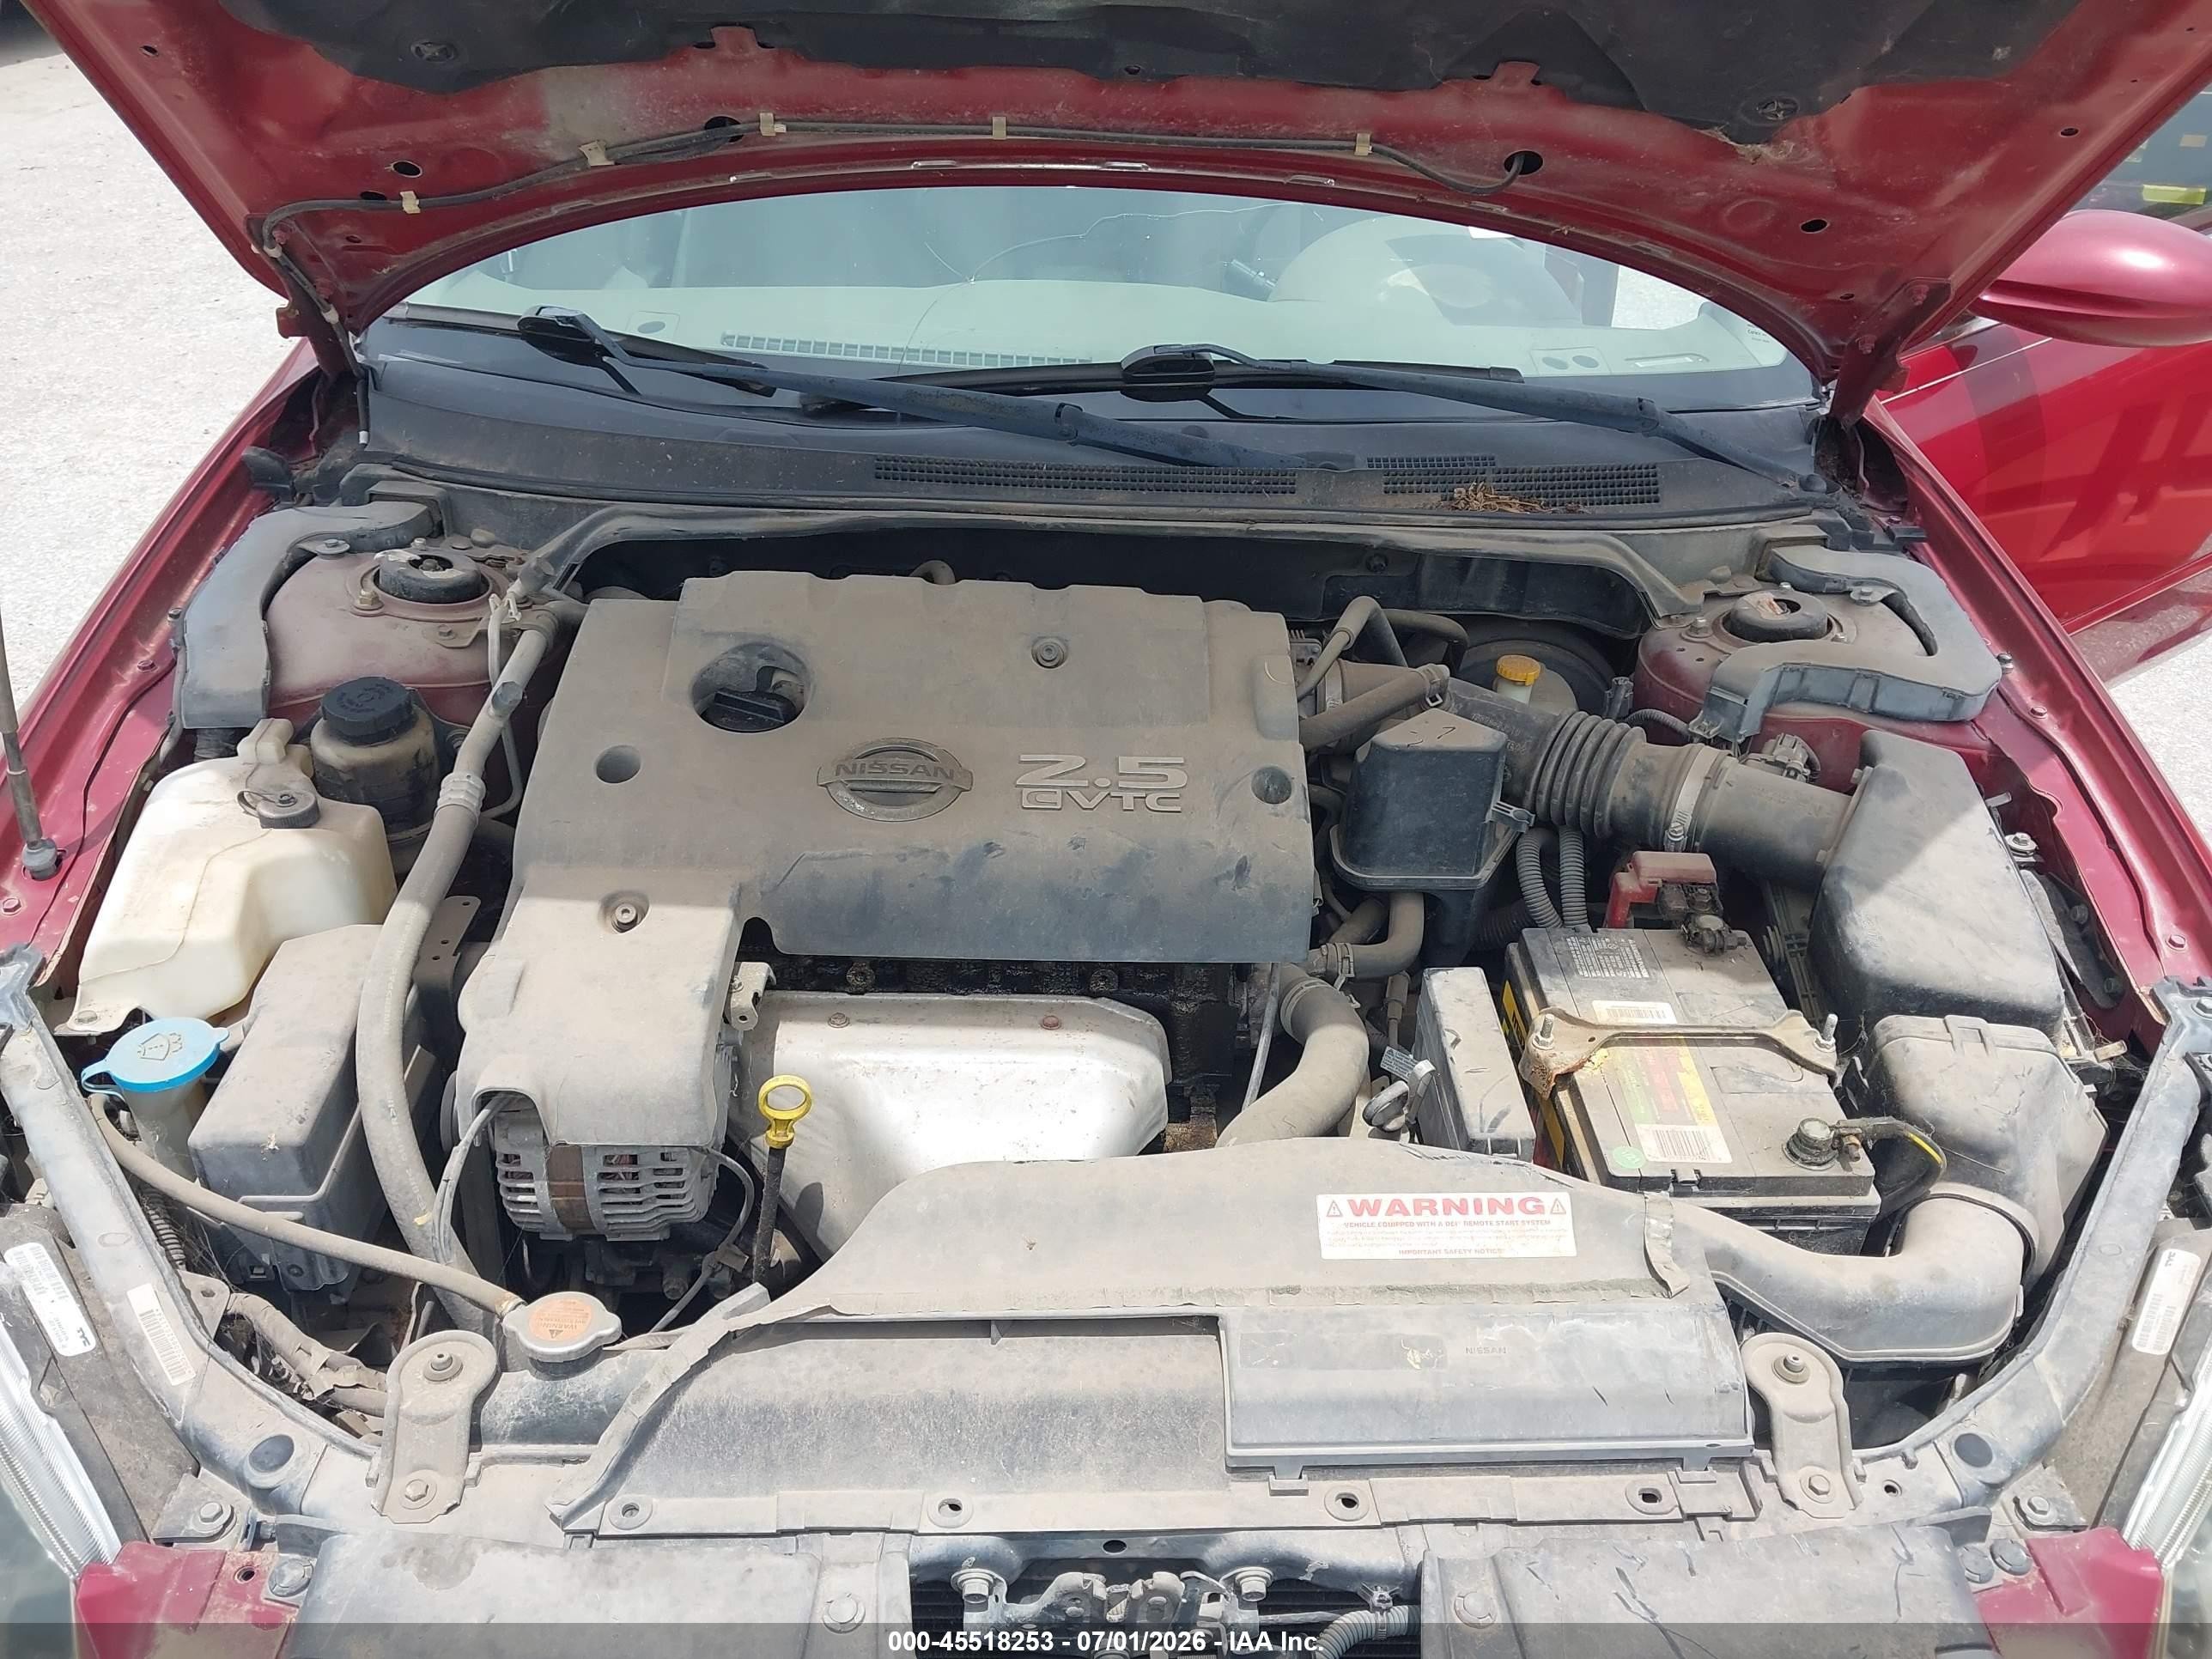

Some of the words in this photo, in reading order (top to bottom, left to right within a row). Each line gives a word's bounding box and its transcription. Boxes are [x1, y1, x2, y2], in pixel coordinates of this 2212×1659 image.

[835, 762, 955, 780] NISSAN
[1017, 754, 1188, 790] 2.5
[1346, 1197, 1545, 1216] WARNING
